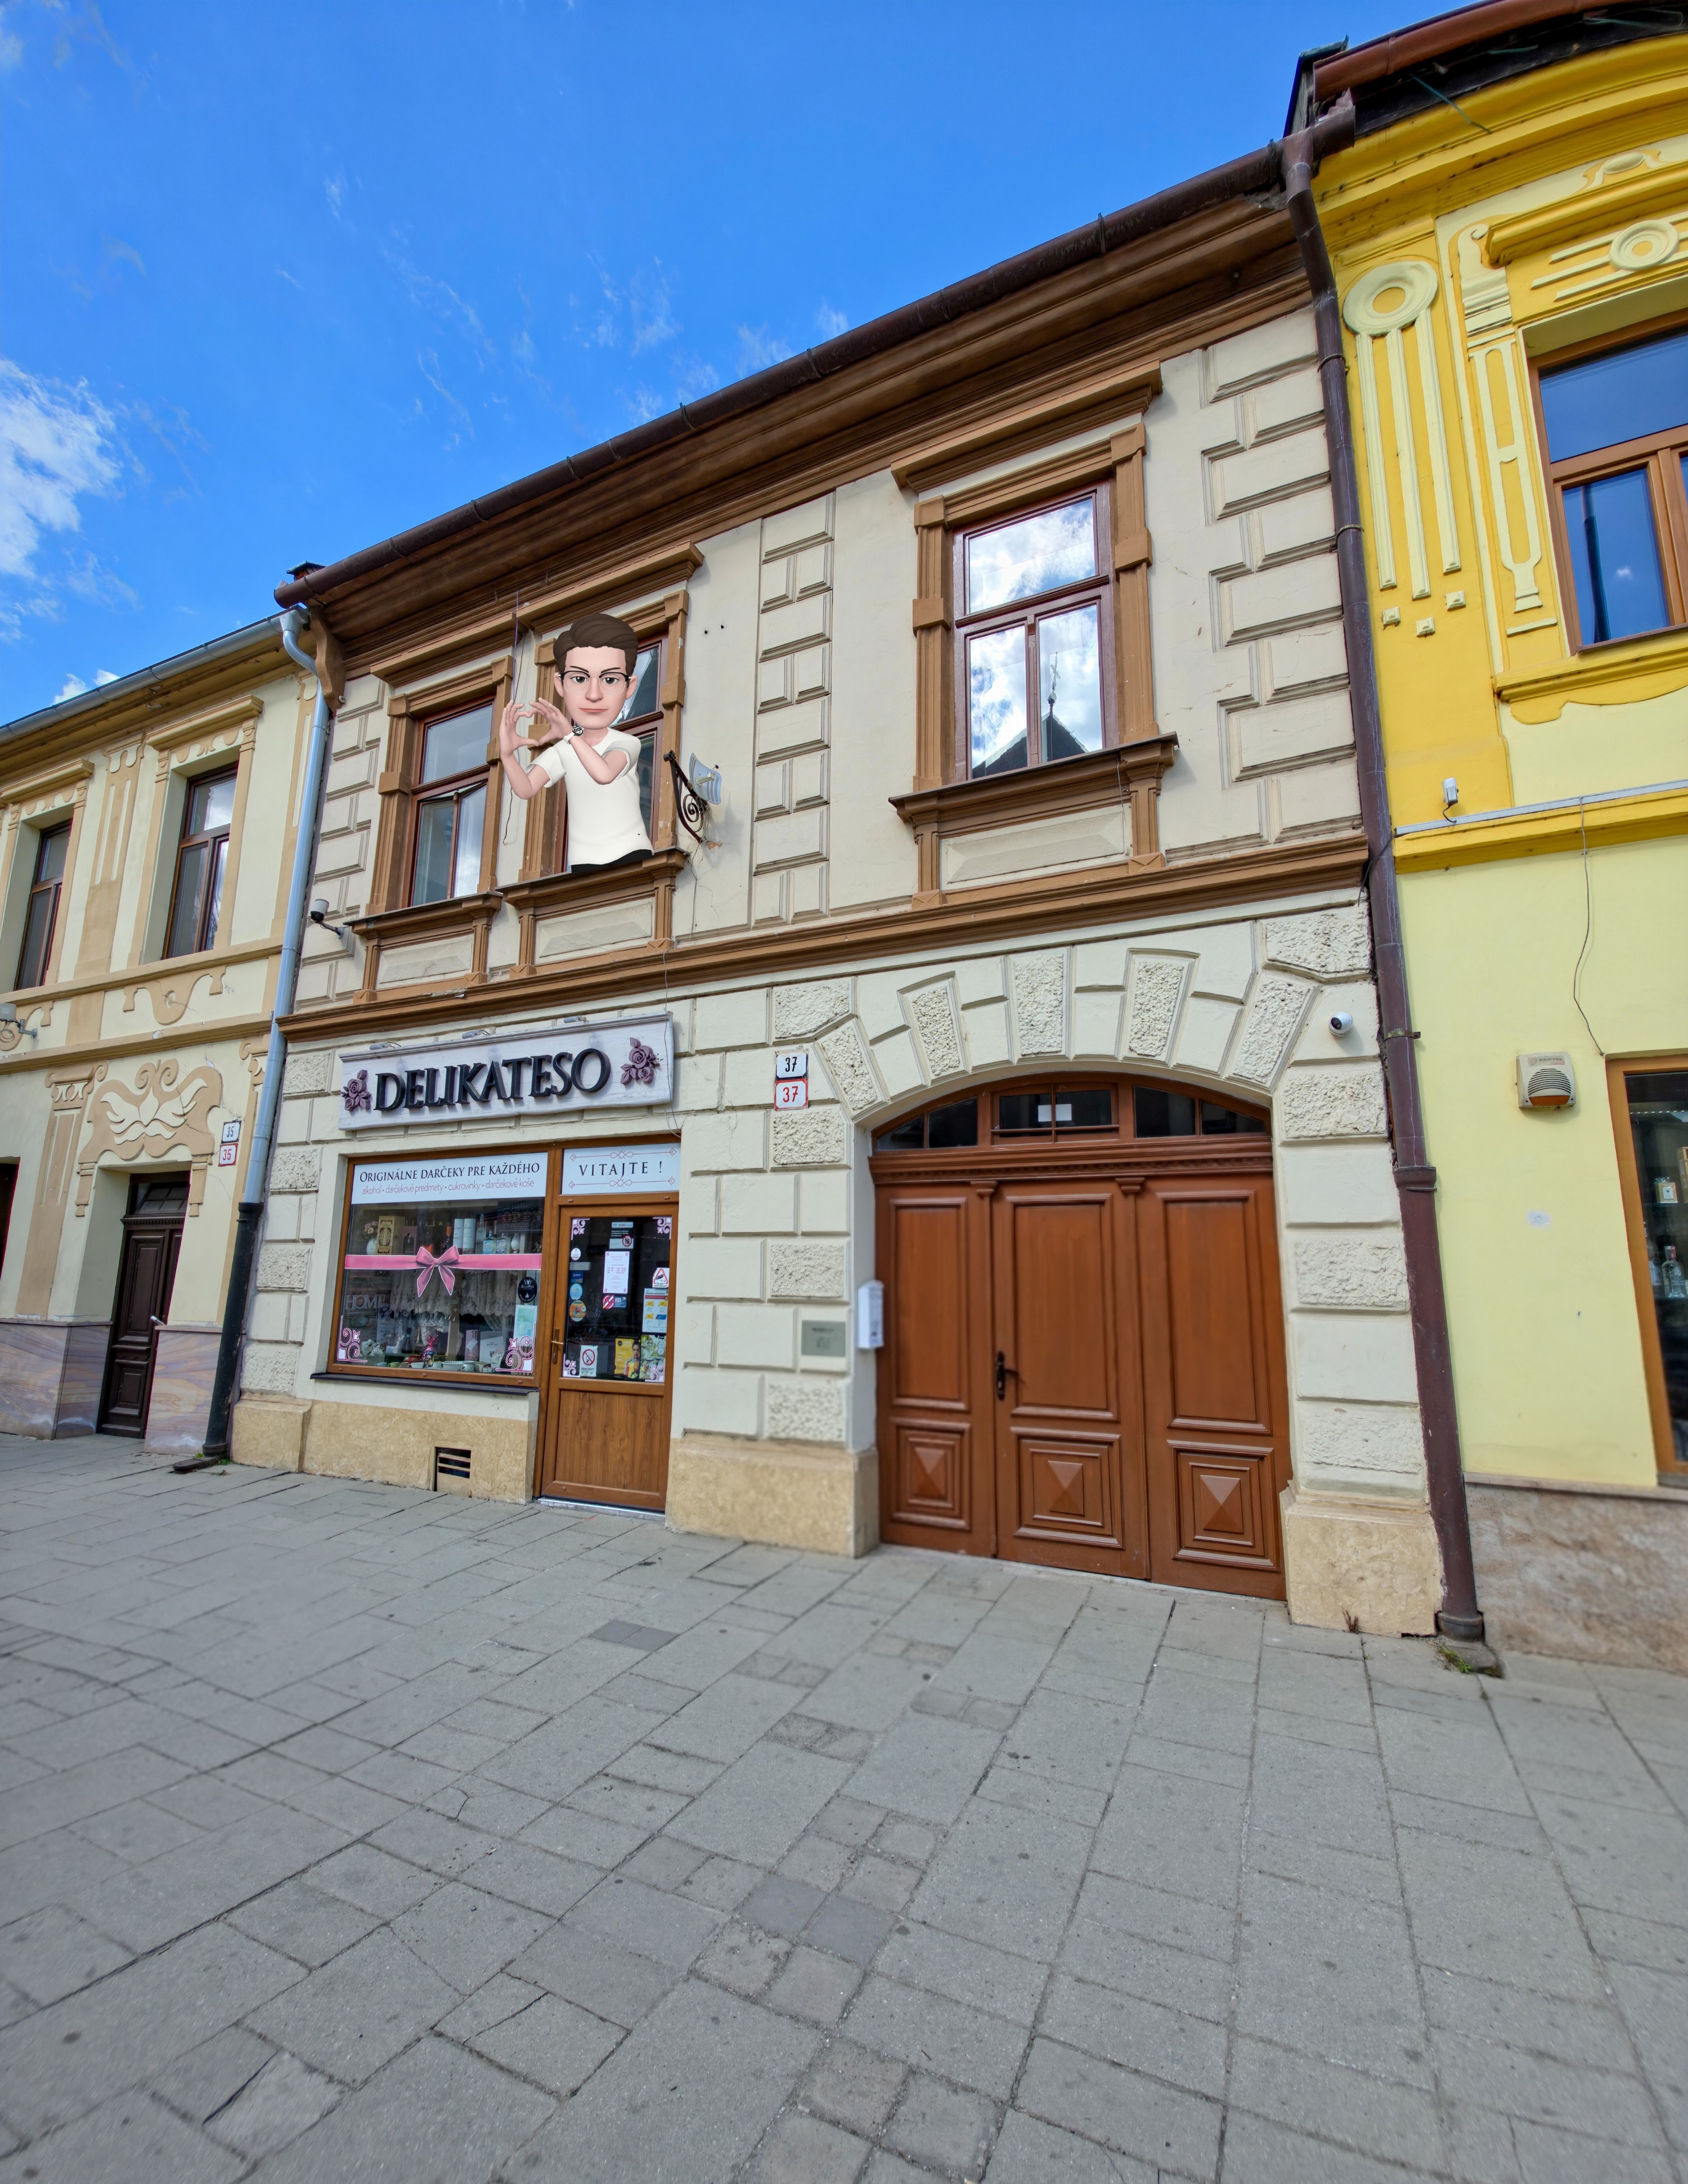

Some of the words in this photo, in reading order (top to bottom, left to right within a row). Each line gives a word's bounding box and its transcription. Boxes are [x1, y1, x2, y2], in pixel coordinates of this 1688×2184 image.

[785, 1056, 797, 1072] 37
[374, 1048, 611, 1112] DELIKATESO
[783, 1086, 798, 1103] 37
[226, 1126, 234, 1138] 35
[223, 1149, 232, 1161] 35
[360, 1169, 417, 1182] ORIGINÁLNE
[421, 1166, 465, 1179] DARČEKY
[468, 1166, 486, 1176] PRE
[489, 1161, 540, 1175] KAŽDÉHO
[579, 1162, 648, 1178] VITAJTE
[362, 1185, 381, 1195] alkohol
[385, 1183, 414, 1194] darčekové
[415, 1183, 444, 1195] predmety
[448, 1180, 481, 1193] cukrovinky
[486, 1178, 518, 1189] darčekové
[519, 1178, 535, 1188] koše
